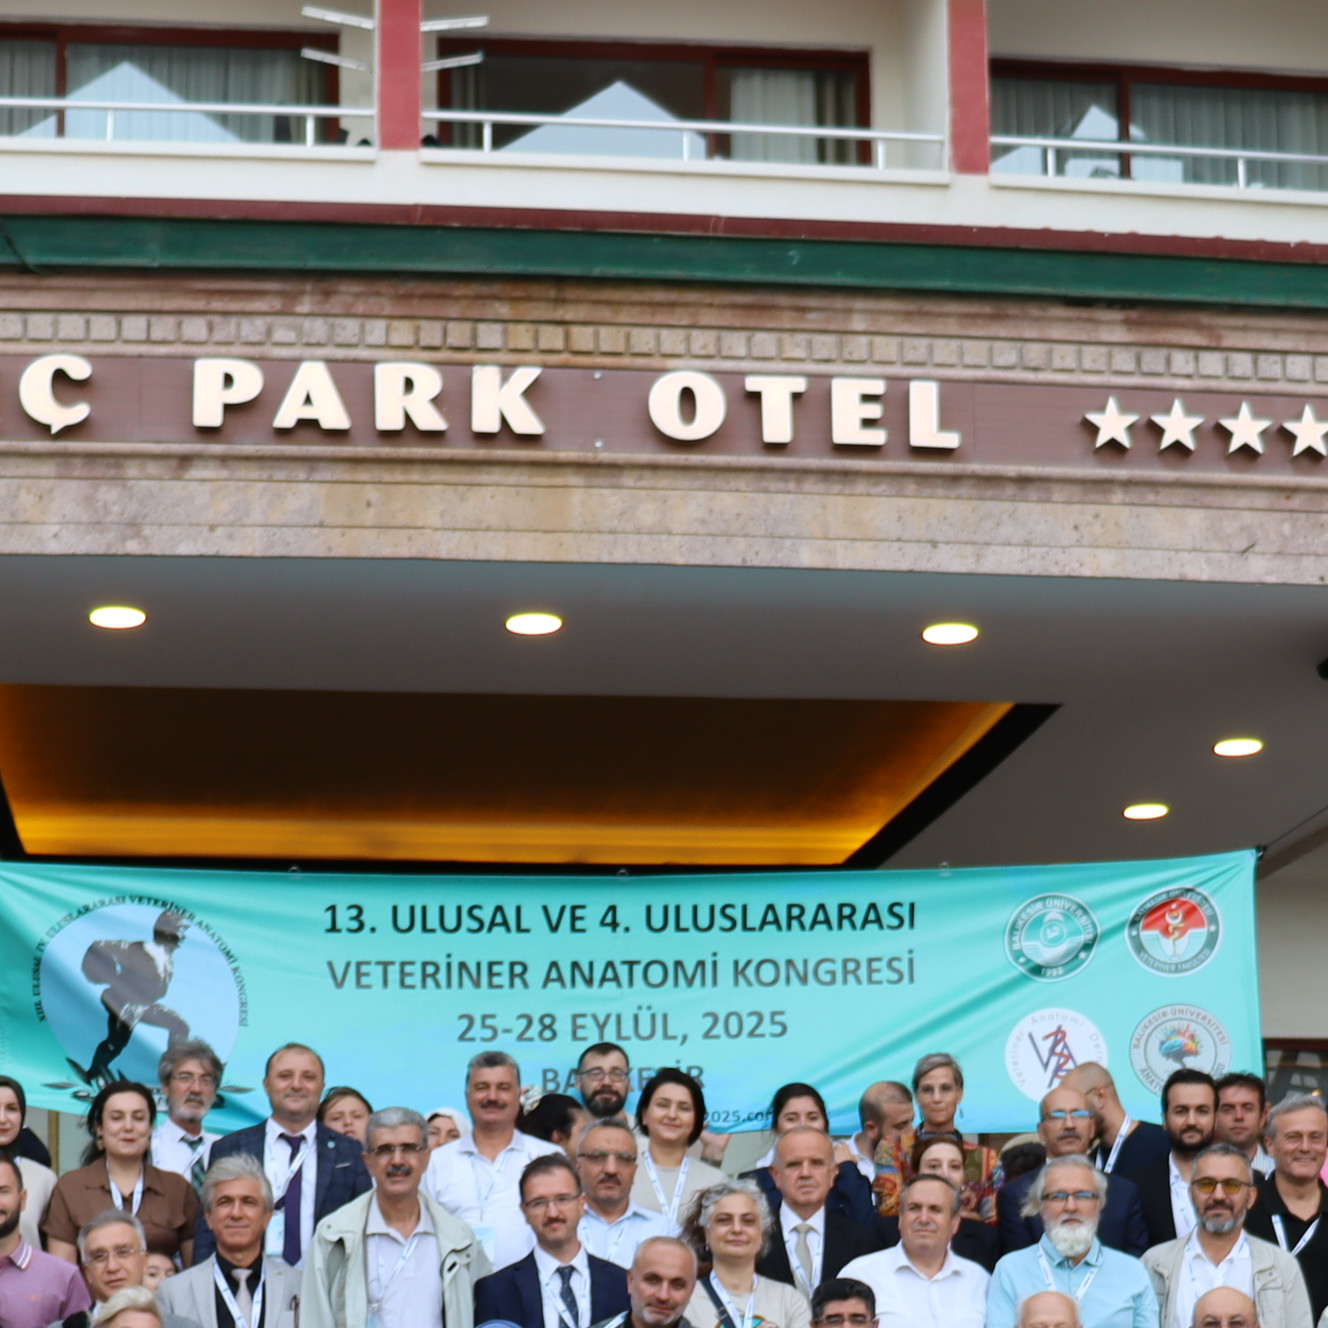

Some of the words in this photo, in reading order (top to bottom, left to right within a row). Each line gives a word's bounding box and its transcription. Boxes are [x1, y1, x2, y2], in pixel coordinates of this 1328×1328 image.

[192, 357, 546, 435] PARK
[648, 370, 962, 449] OTEL
[324, 904, 377, 934] 13.
[391, 904, 532, 934] ULUSAL
[542, 904, 588, 934] VE
[599, 904, 631, 934] 4.
[645, 901, 916, 934] ULUSLARARASI
[327, 953, 530, 990] VETERİNER
[541, 951, 719, 990] ANATOMİ
[732, 949, 916, 988] KONGRESİ
[457, 1013, 558, 1042] 25-28
[571, 1005, 689, 1046] EYLÜL,
[701, 1010, 788, 1041] 2025
